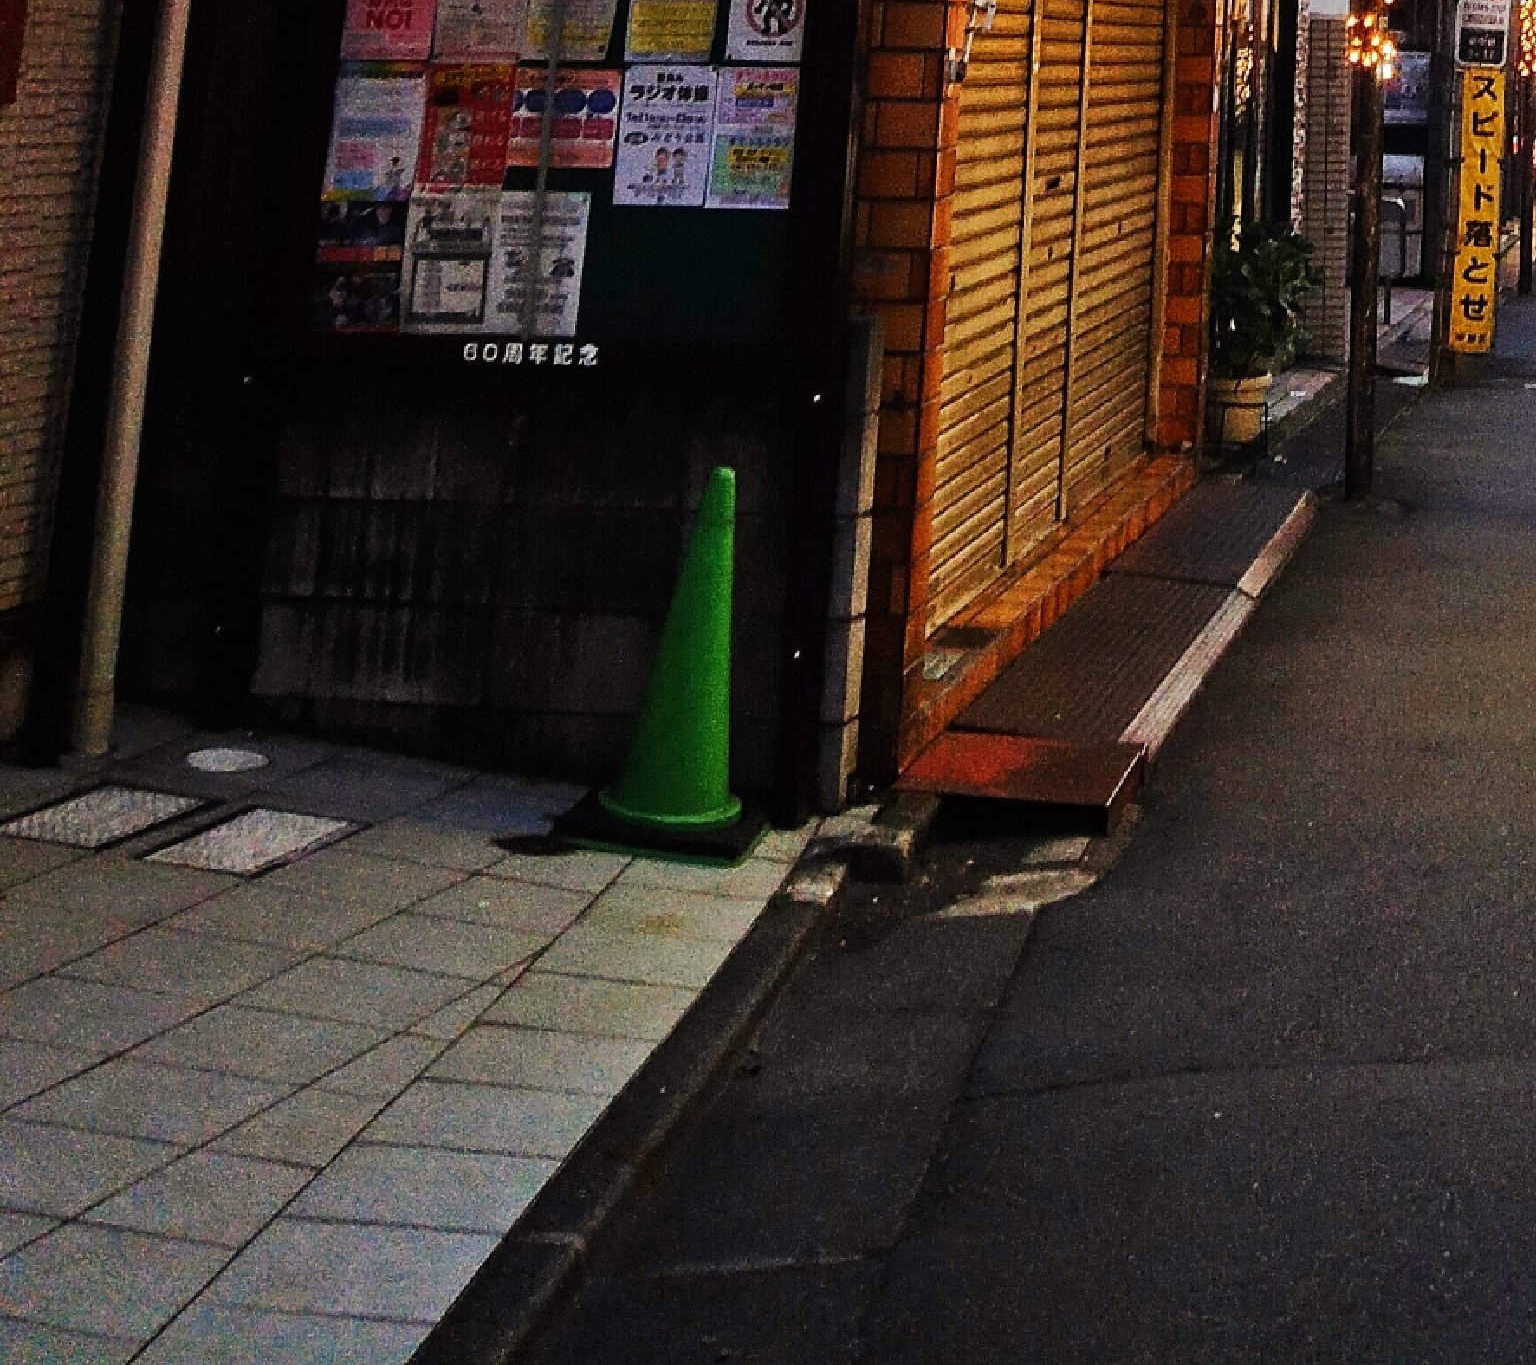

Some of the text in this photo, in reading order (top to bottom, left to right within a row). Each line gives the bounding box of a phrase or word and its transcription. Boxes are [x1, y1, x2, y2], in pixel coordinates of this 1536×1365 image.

[1458, 74, 1499, 321] スピード落とせ
[463, 342, 600, 366] 60周年記念
